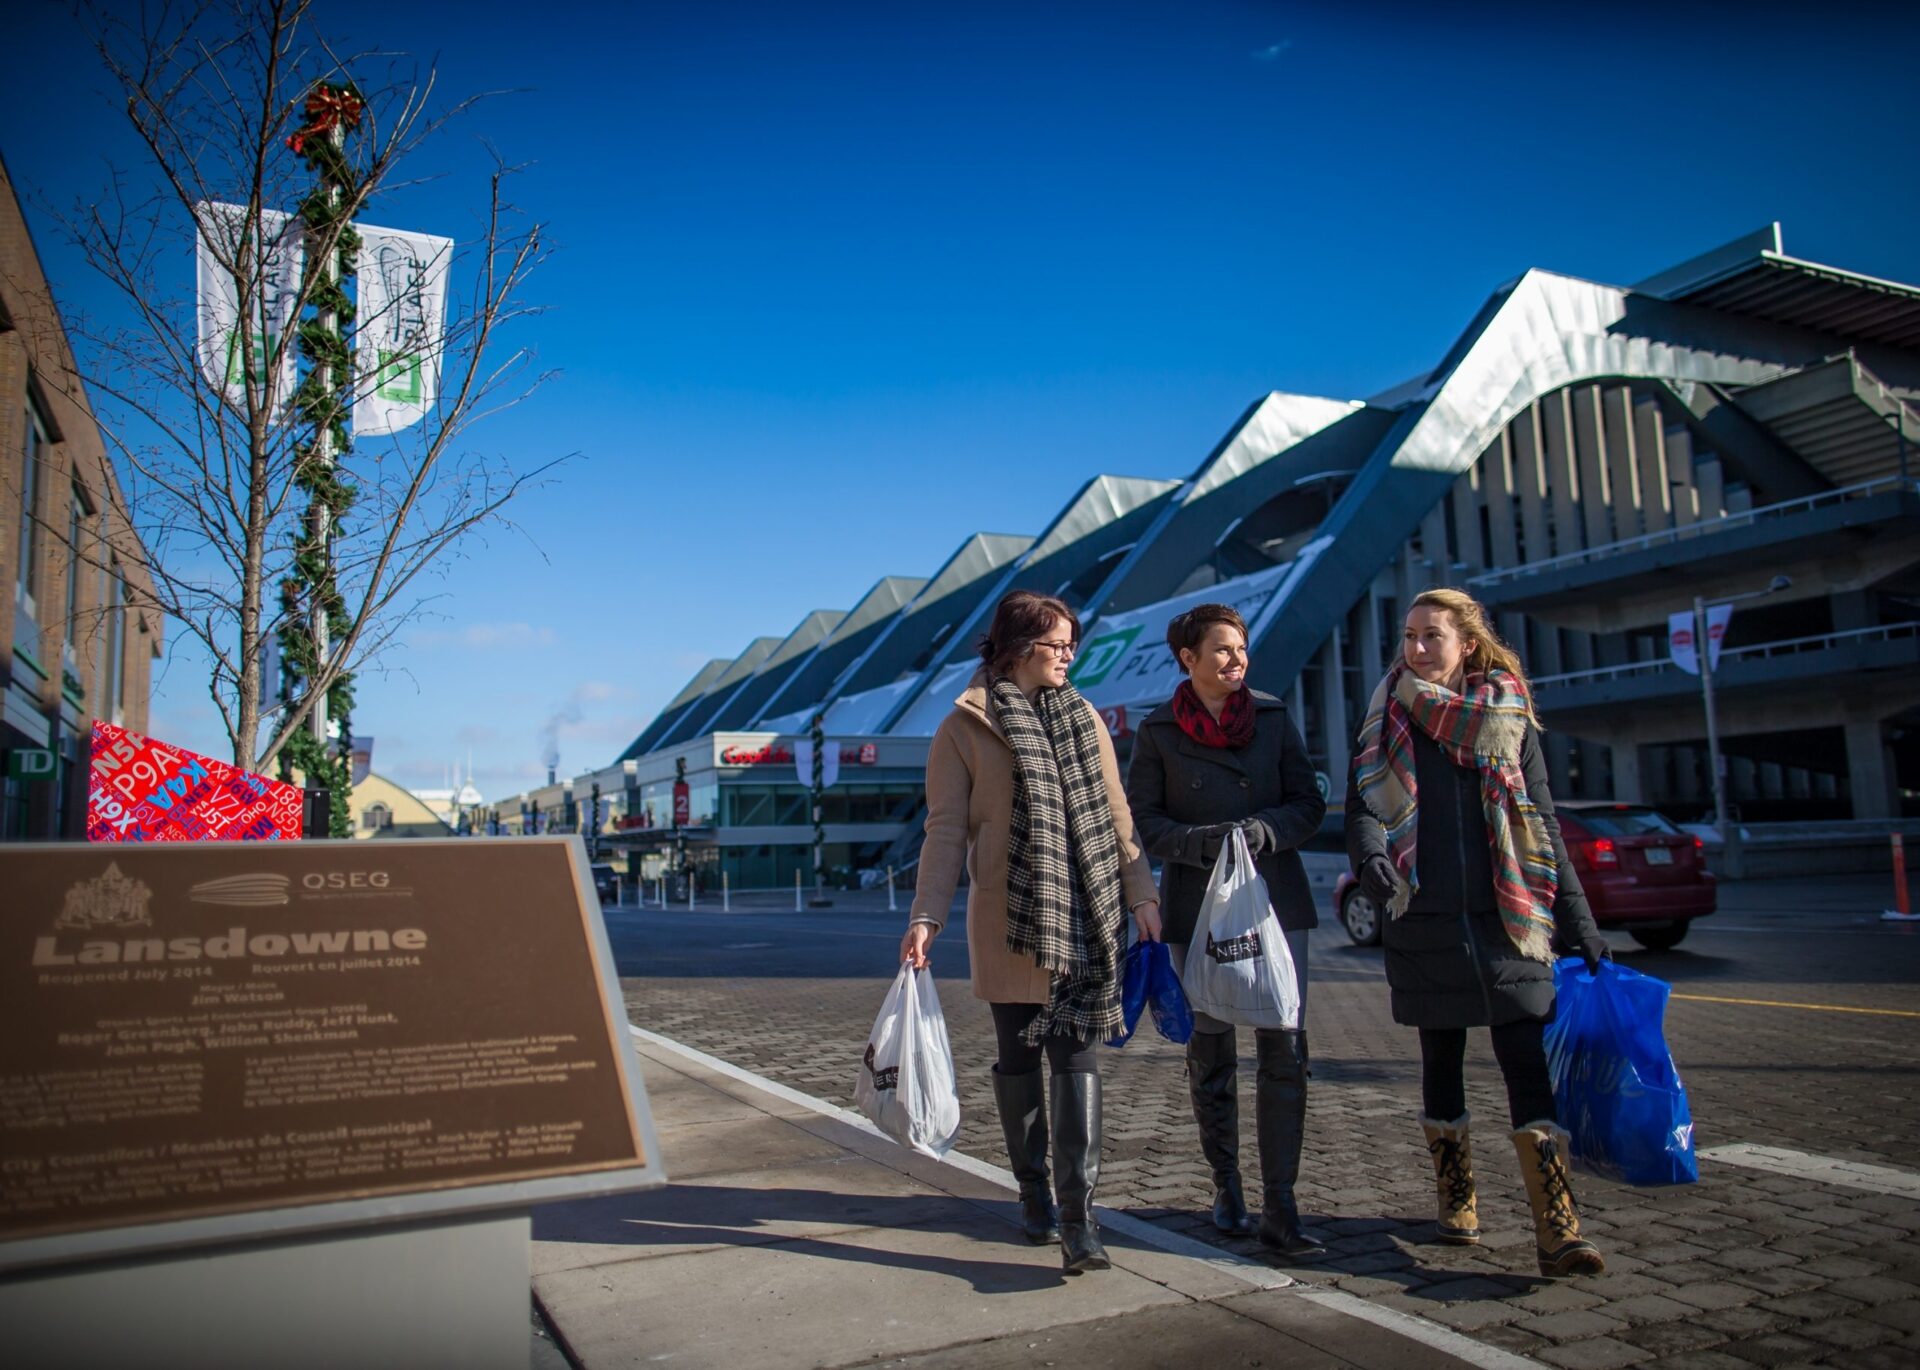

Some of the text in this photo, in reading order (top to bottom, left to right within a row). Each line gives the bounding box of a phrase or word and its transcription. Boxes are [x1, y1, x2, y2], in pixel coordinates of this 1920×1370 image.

[13, 749, 54, 773] TD
[112, 747, 182, 802] P9A
[145, 758, 209, 812] K4A
[89, 787, 139, 836] H9X
[676, 794, 689, 813] 2
[200, 807, 230, 832] J5T
[302, 871, 391, 890] OSEG
[32, 928, 428, 967] Lansdowne
[133, 968, 168, 982] July
[173, 966, 213, 979] 2014
[252, 956, 421, 974] Rouvert en juillet 2014
[192, 991, 285, 1005] Jim Watson
